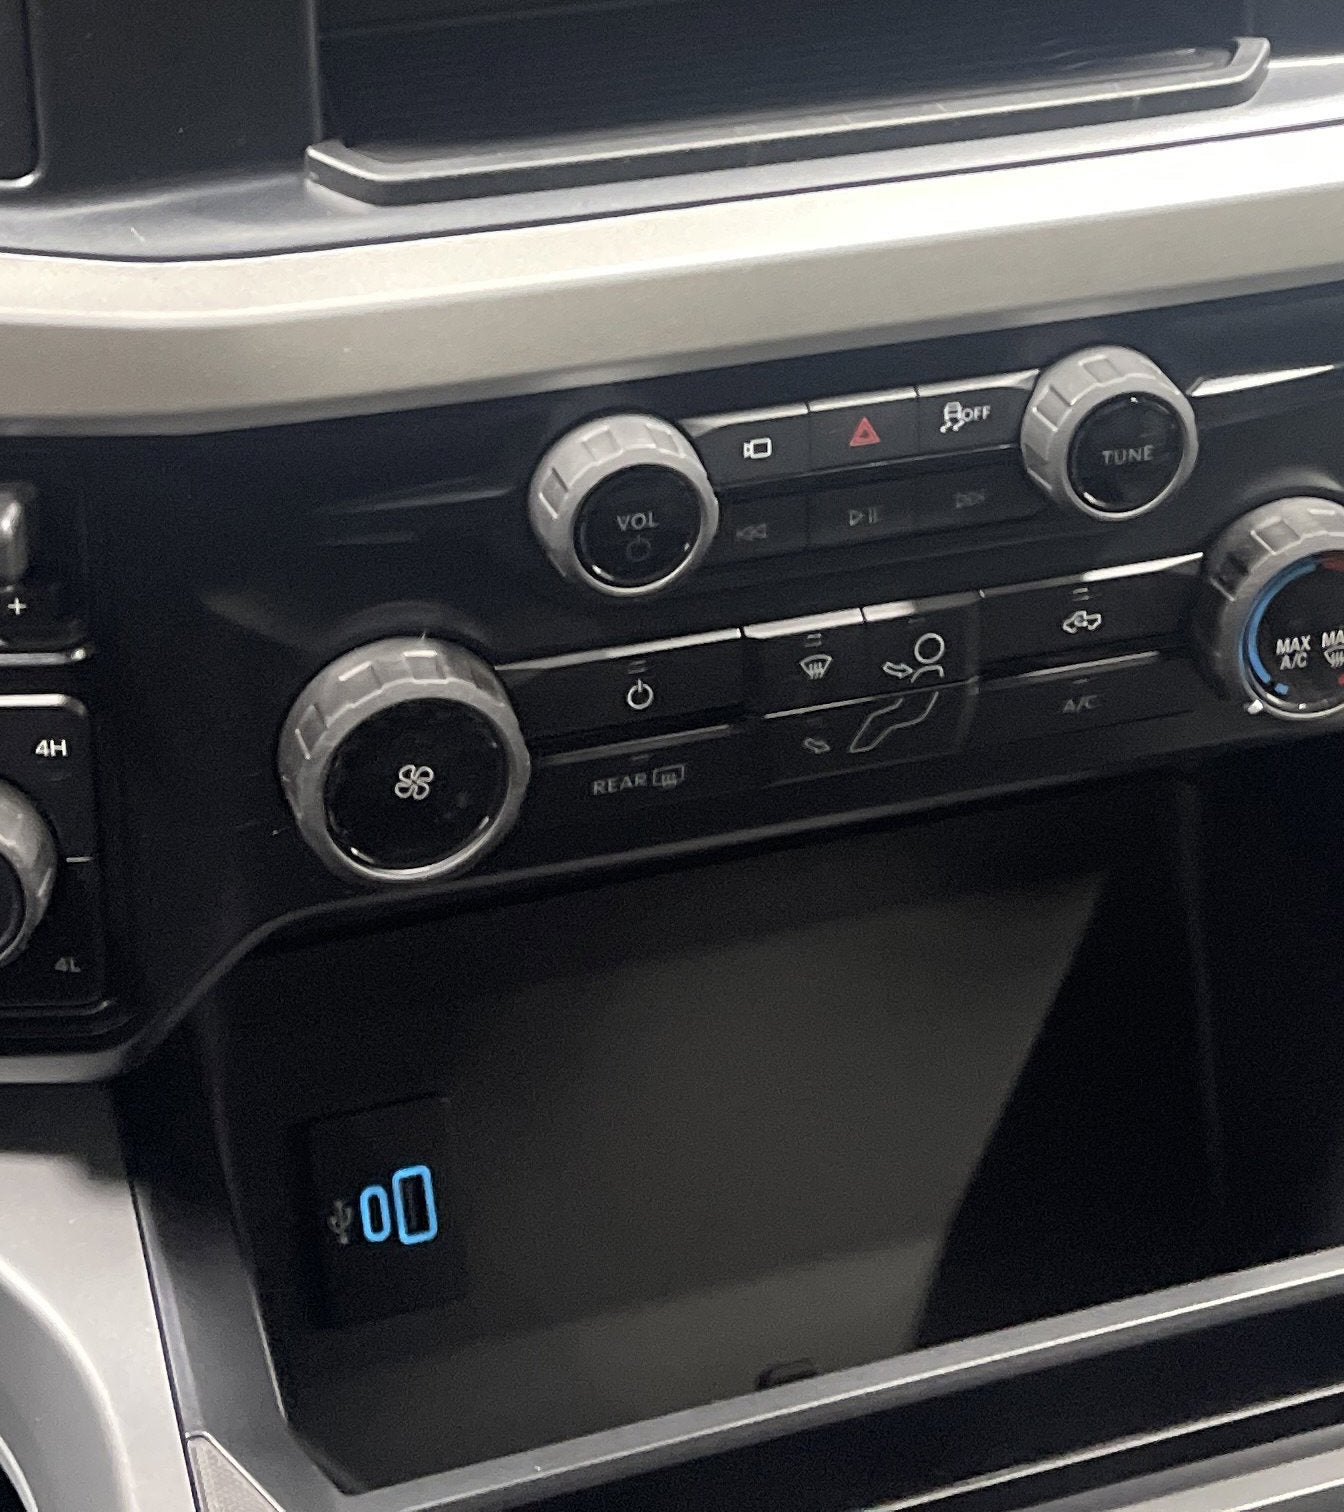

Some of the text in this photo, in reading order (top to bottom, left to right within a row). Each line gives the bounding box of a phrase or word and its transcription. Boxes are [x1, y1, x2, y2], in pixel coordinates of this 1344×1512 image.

[962, 404, 991, 422] OFF
[1102, 445, 1155, 466] TUNE
[616, 511, 660, 532] VOL
[1276, 634, 1311, 656] MAX
[1280, 651, 1308, 670] A/C
[1062, 694, 1098, 714] A/C
[34, 738, 68, 758] 4H
[593, 772, 647, 796] REAR
[55, 956, 81, 974] 4L
